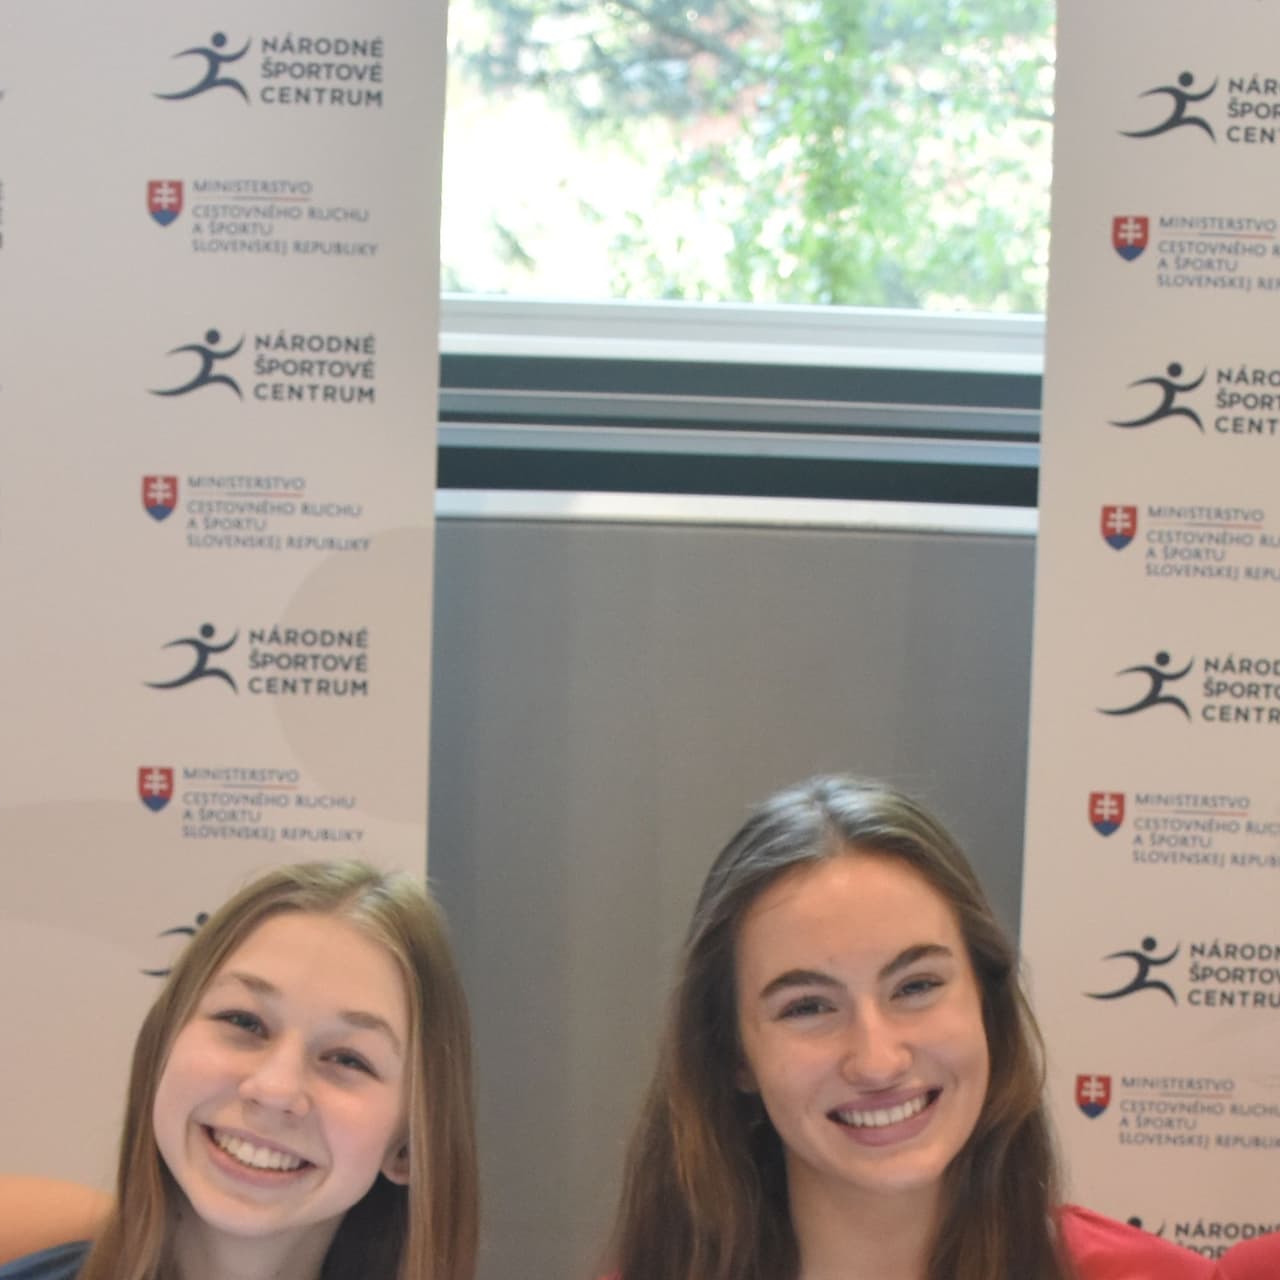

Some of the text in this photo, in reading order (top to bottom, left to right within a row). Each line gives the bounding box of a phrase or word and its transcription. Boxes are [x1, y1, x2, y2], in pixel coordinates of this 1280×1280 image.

[261, 33, 383, 57] NÁRODNÉ
[261, 56, 382, 82] ŠPORTOVÉ
[260, 86, 382, 107] CENTRUM
[1160, 217, 1277, 232] MINISTERSTVO
[1175, 256, 1237, 271] ŠPORTU
[1157, 274, 1251, 291] SLOVENSKEJ
[254, 330, 375, 354] NÁRODNÉ
[254, 353, 374, 379] ŠPORTOVÉ
[253, 383, 374, 403] CENTRUM
[1148, 507, 1264, 522] MINISTERSTVO
[1163, 546, 1225, 561] ŠPORTU
[1145, 564, 1238, 581] SLOVENSKEJ
[248, 624, 368, 648] NÁRODNÉ
[248, 648, 367, 672] ŠPORTOVÉ
[247, 677, 368, 696] CENTRUM
[1122, 1078, 1234, 1091] MINISTERSTVO
[1136, 1115, 1196, 1129] ŠPORTU
[1118, 1133, 1209, 1148] SLOVENSKEJ
